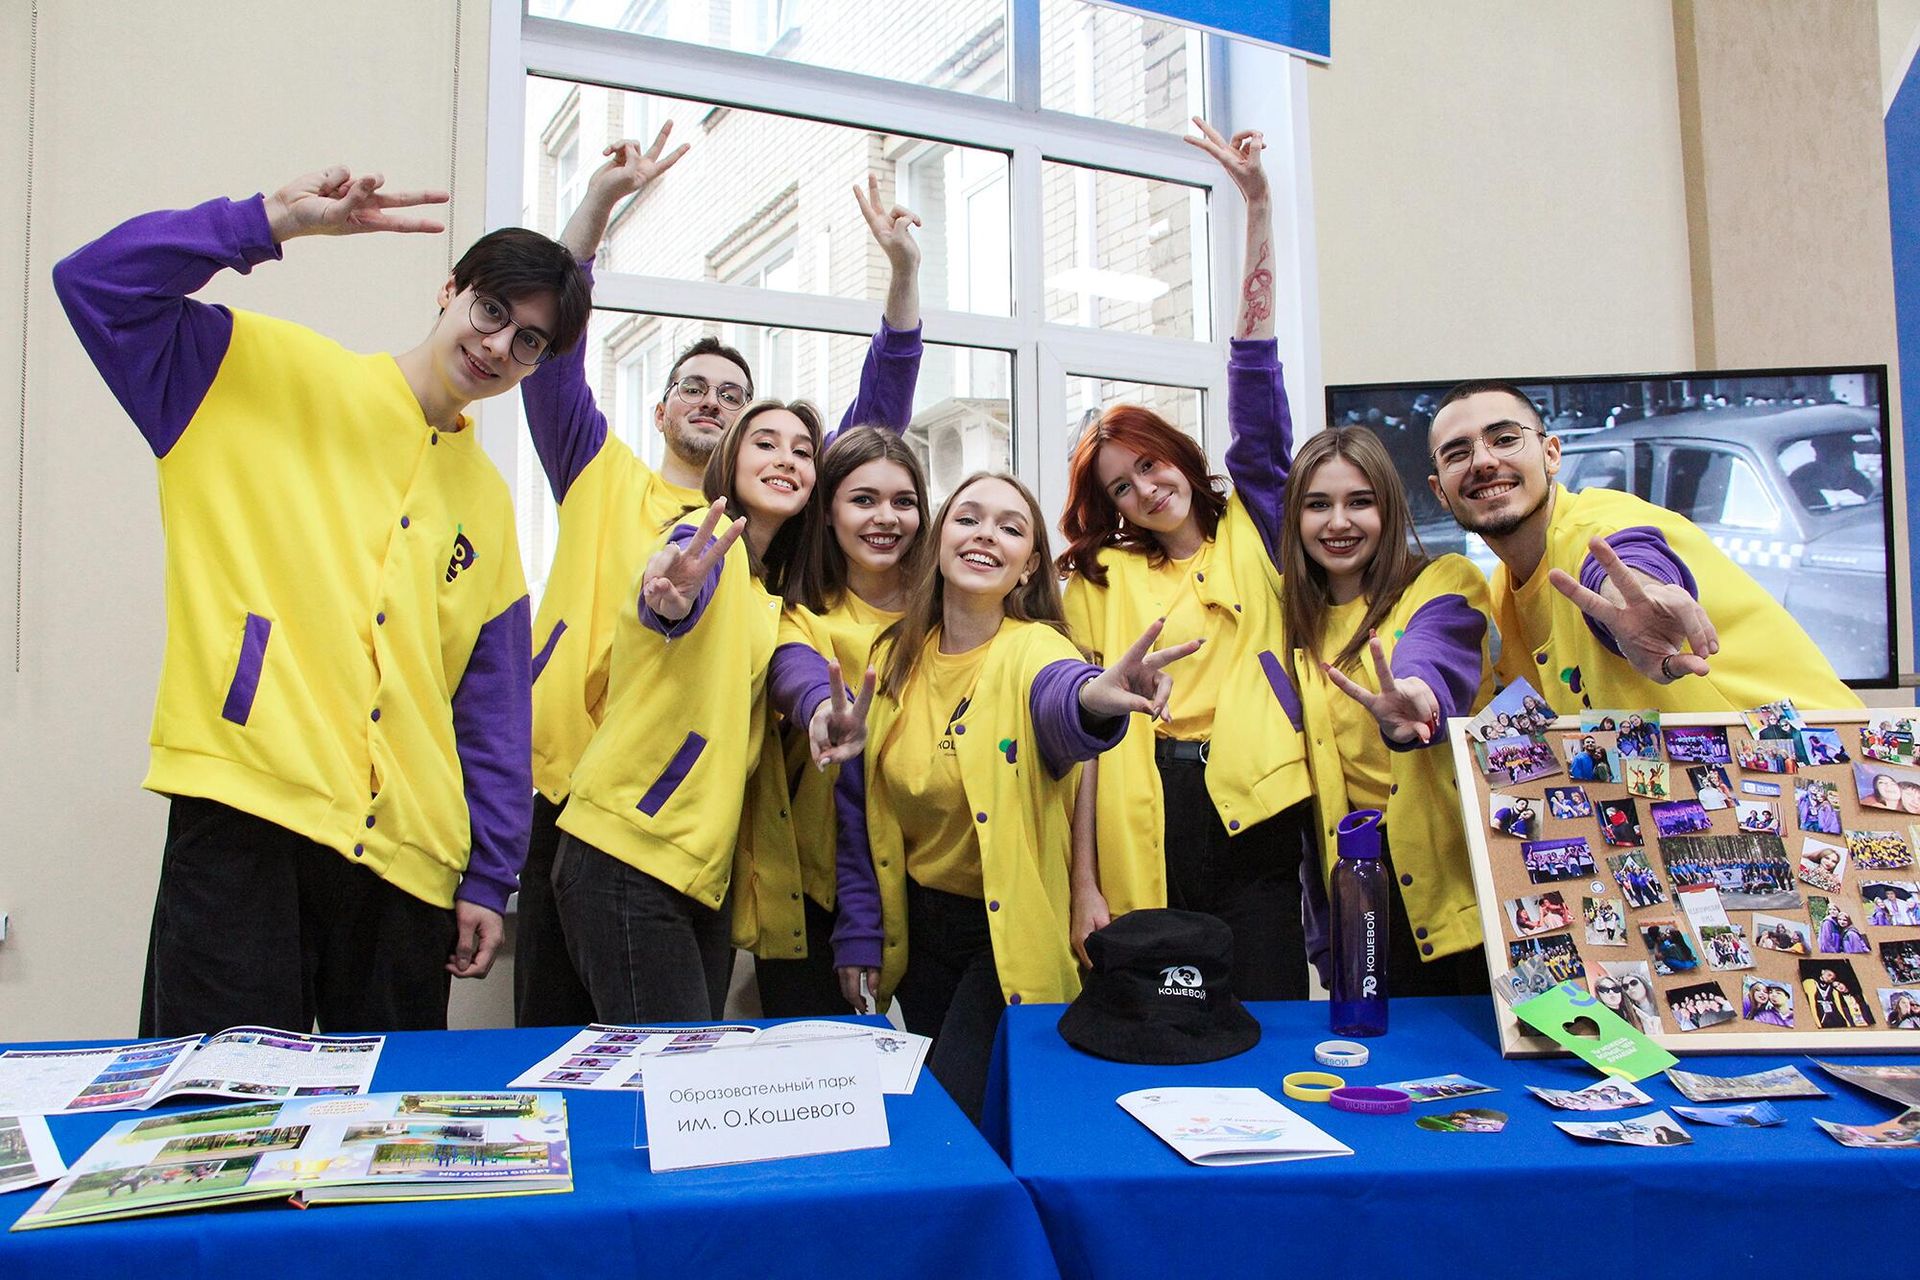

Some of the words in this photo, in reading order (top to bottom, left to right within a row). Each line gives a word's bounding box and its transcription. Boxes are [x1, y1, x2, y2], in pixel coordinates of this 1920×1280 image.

[1364, 911, 1375, 972] КОШЕВОЙ
[1158, 987, 1206, 1000] КОШЕВОЙ
[669, 1077, 814, 1104] Образовательный
[818, 1075, 857, 1092] парк
[677, 1117, 717, 1132] им.
[723, 1101, 856, 1128] О.Кошевого
